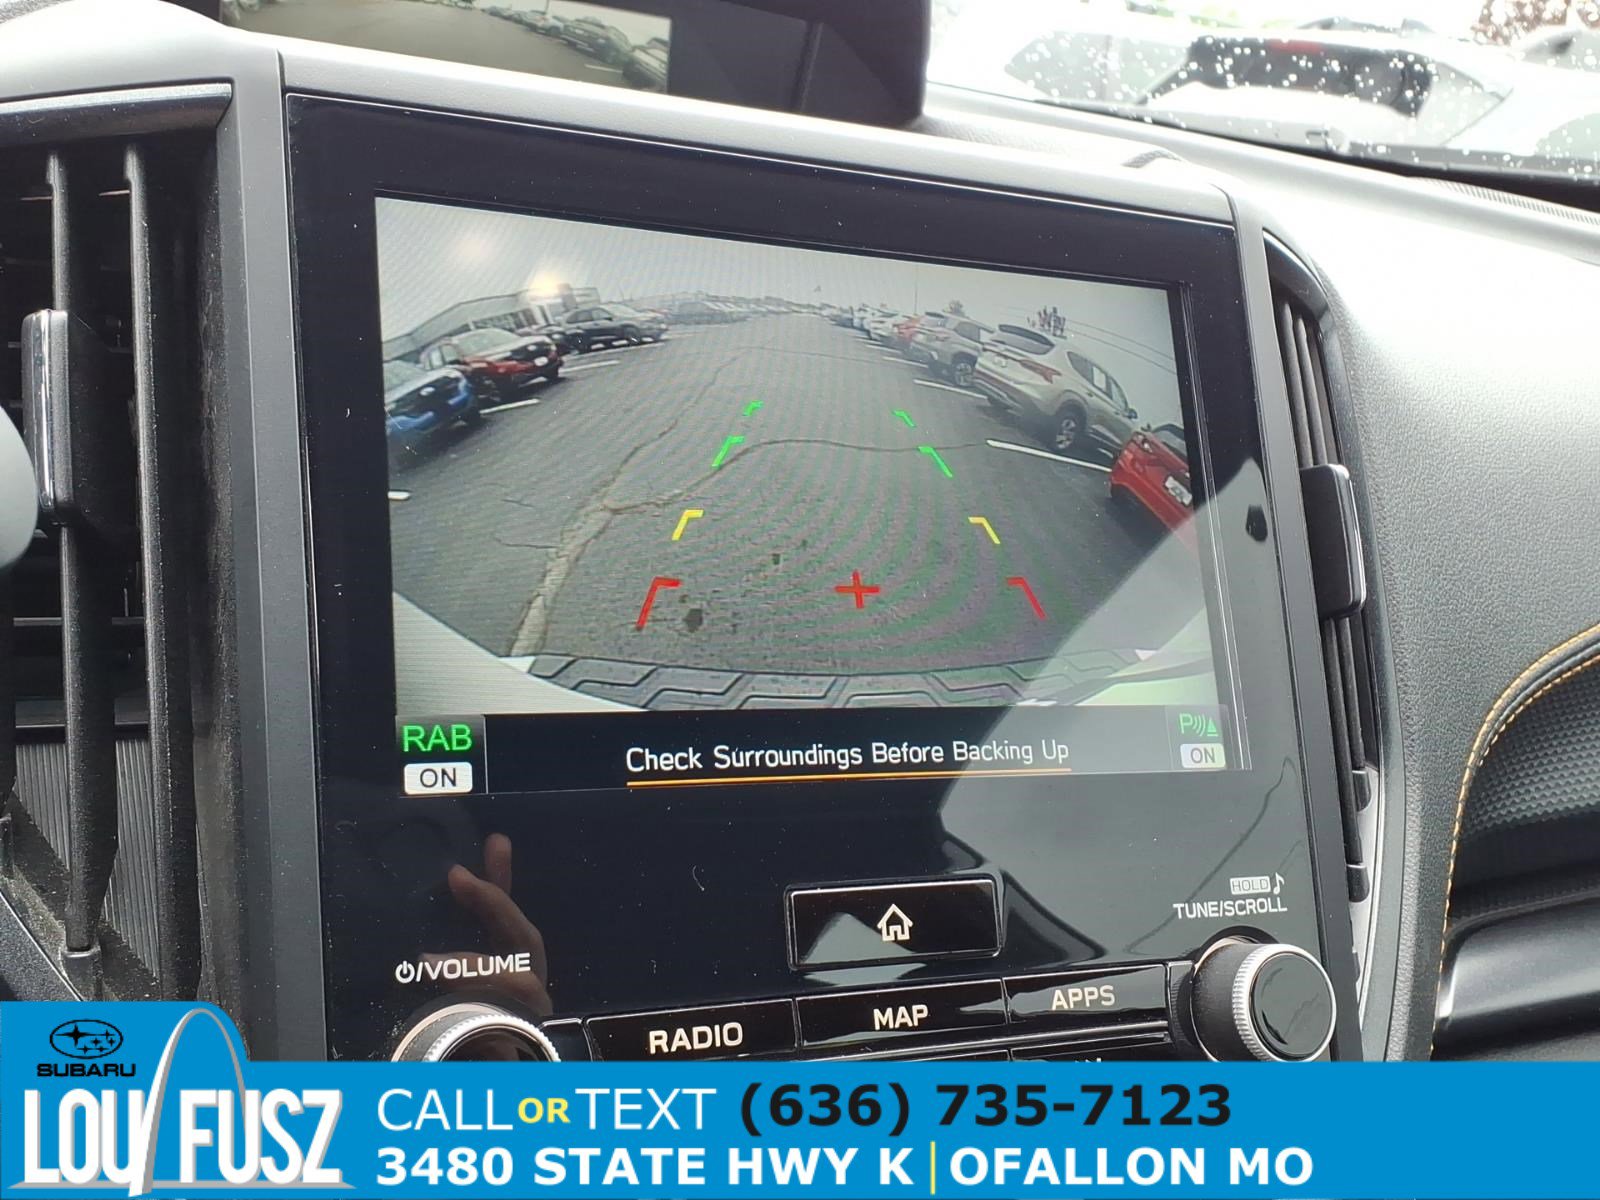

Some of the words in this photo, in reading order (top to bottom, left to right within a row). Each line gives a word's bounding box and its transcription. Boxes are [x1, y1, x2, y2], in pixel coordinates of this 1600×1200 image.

[402, 724, 473, 752] RAB
[626, 745, 703, 773] Check
[713, 741, 863, 770] Surroundings
[871, 741, 945, 764] Before
[953, 739, 1034, 767] Backing
[1042, 739, 1070, 764] Up
[1189, 747, 1215, 764] ON
[419, 767, 457, 788] ON
[1232, 878, 1270, 893] HOLD
[1172, 897, 1288, 919] TUNE/SCROLL
[1051, 985, 1116, 1011] APPS
[873, 1004, 929, 1030] MAP
[649, 1021, 744, 1055] RADIO
